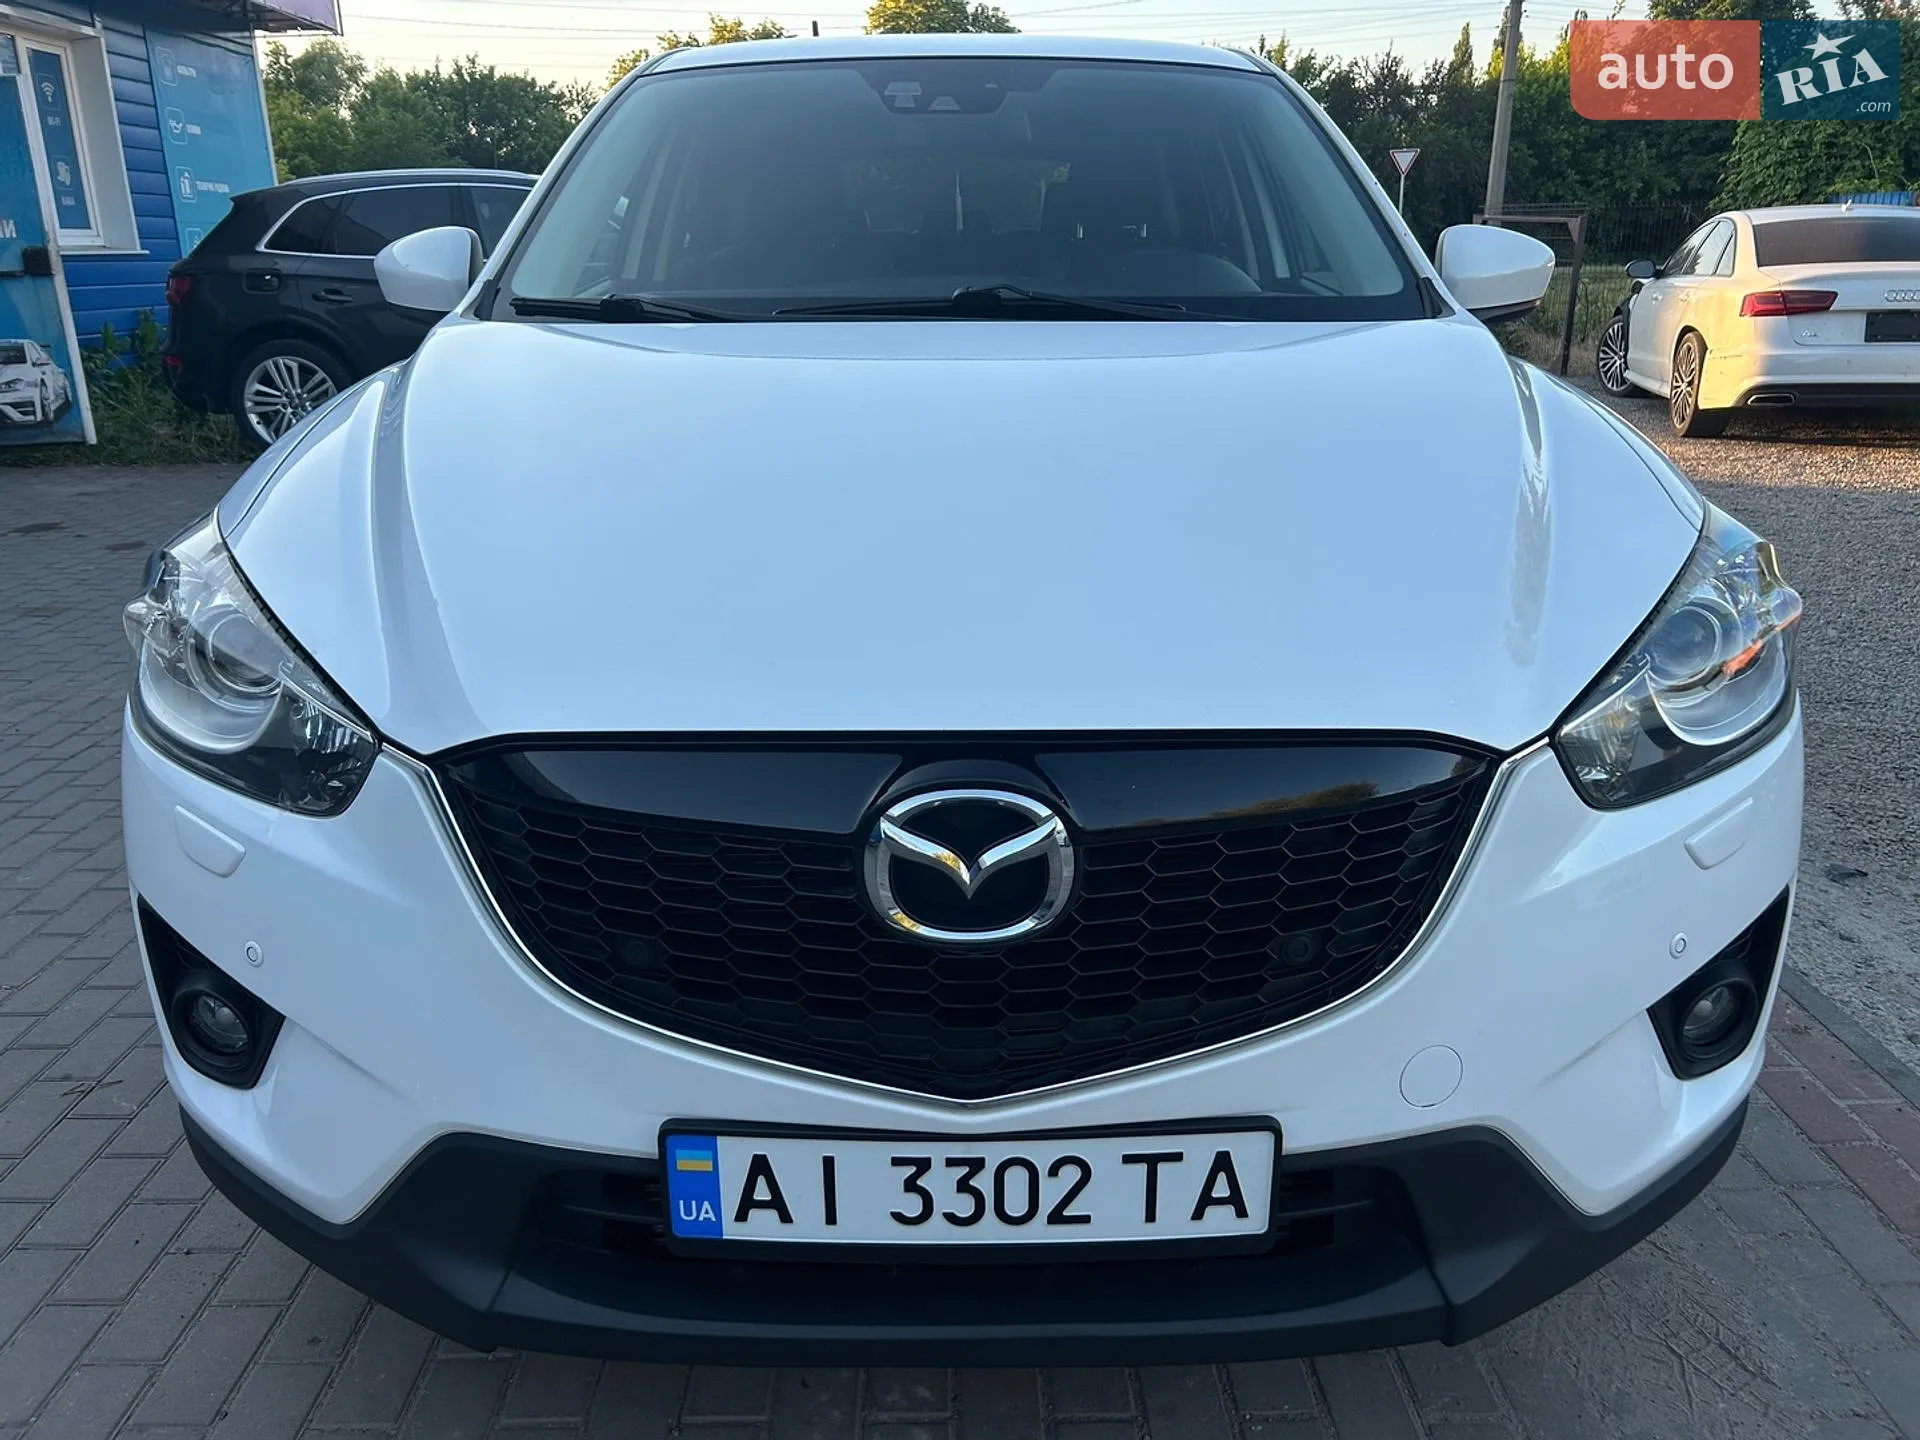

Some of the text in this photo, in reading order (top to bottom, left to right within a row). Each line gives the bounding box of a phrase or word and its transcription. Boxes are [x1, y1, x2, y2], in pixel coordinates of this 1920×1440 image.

[679, 1200, 716, 1222] UA
[734, 1150, 1250, 1227] AI 3302 TA
